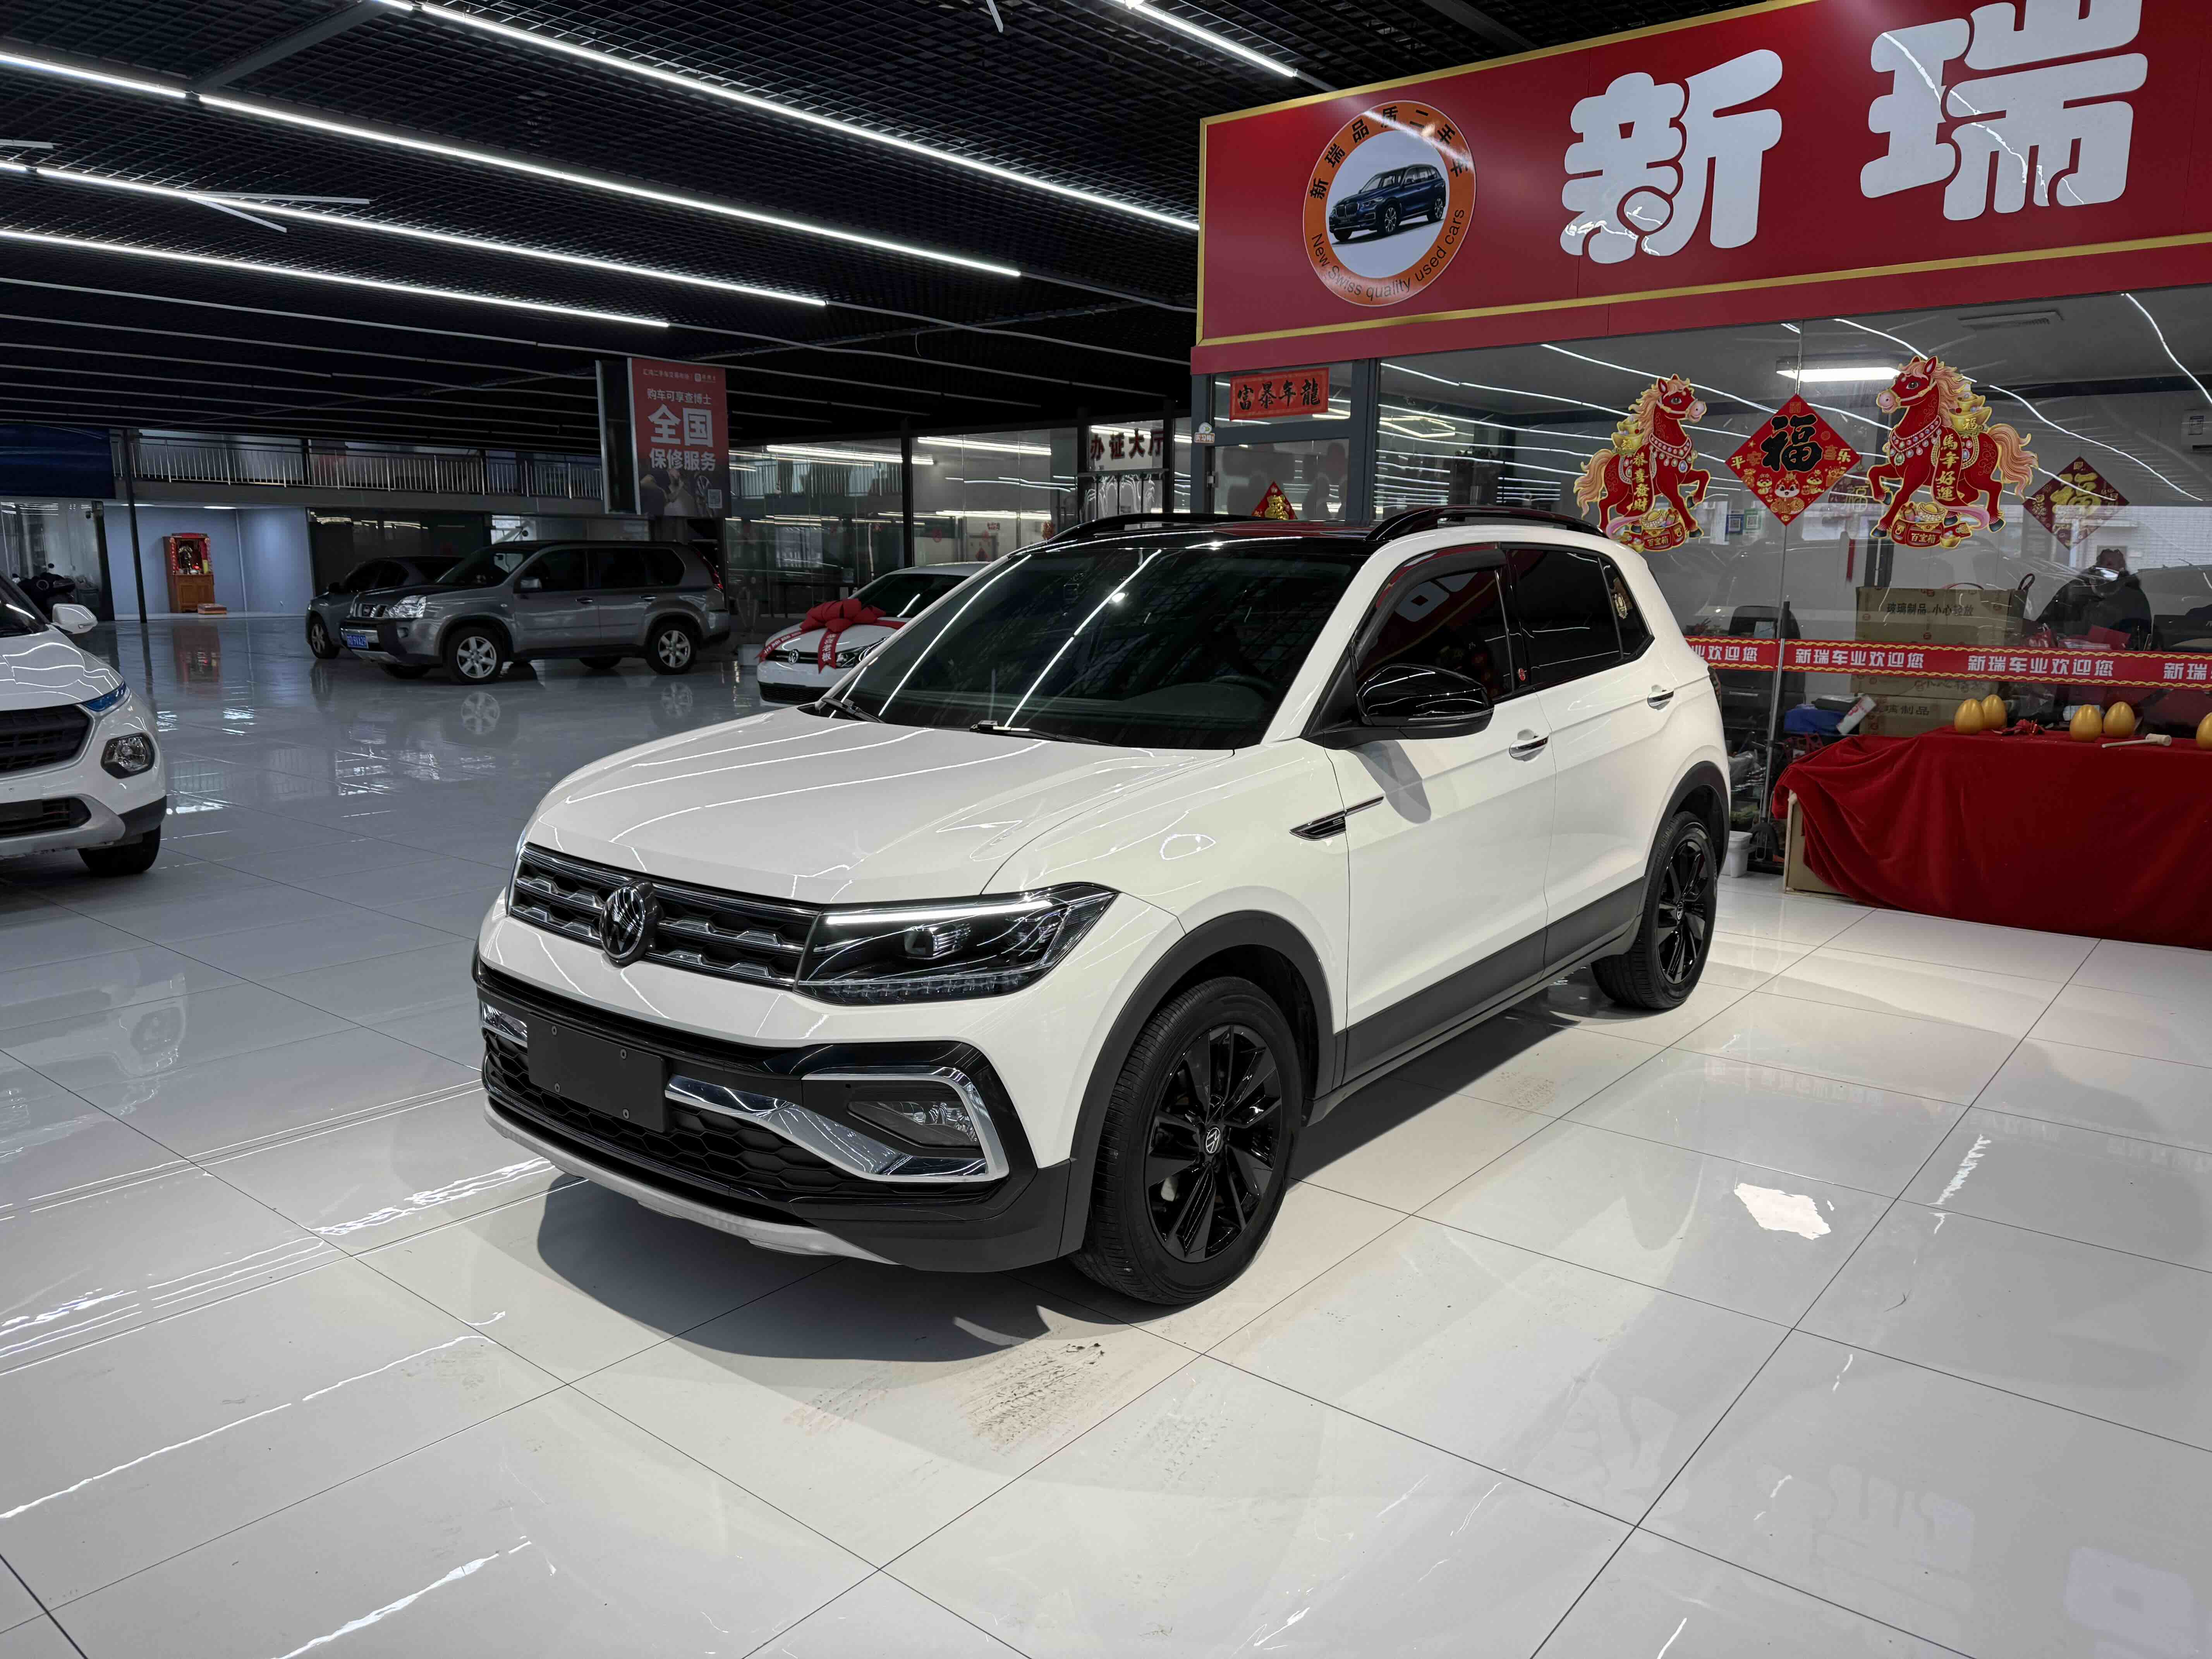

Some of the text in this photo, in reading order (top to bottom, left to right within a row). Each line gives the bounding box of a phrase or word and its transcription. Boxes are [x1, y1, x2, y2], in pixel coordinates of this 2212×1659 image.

[1312, 208, 1465, 301] New Swiss quality used cars
[647, 388, 713, 405] 购车可享查博士
[647, 403, 714, 448] 全国
[1962, 417, 1977, 431] 福
[1090, 427, 1165, 461] 办证大厅
[1760, 414, 1824, 473] 福
[649, 448, 716, 471] 保修服务
[1731, 445, 1851, 470] 平安 喜乐
[1935, 433, 1960, 501] 馬年好運
[1633, 452, 1649, 512] 恭喜發財
[1911, 532, 1936, 544] 百宝箱
[1887, 603, 1974, 617] 玻璃制品 小心轻放
[1795, 648, 1925, 669] 新瑞车业欢迎您
[1968, 655, 2114, 677] 新瑞车业欢迎您
[2163, 662, 2212, 680] 新瑞
